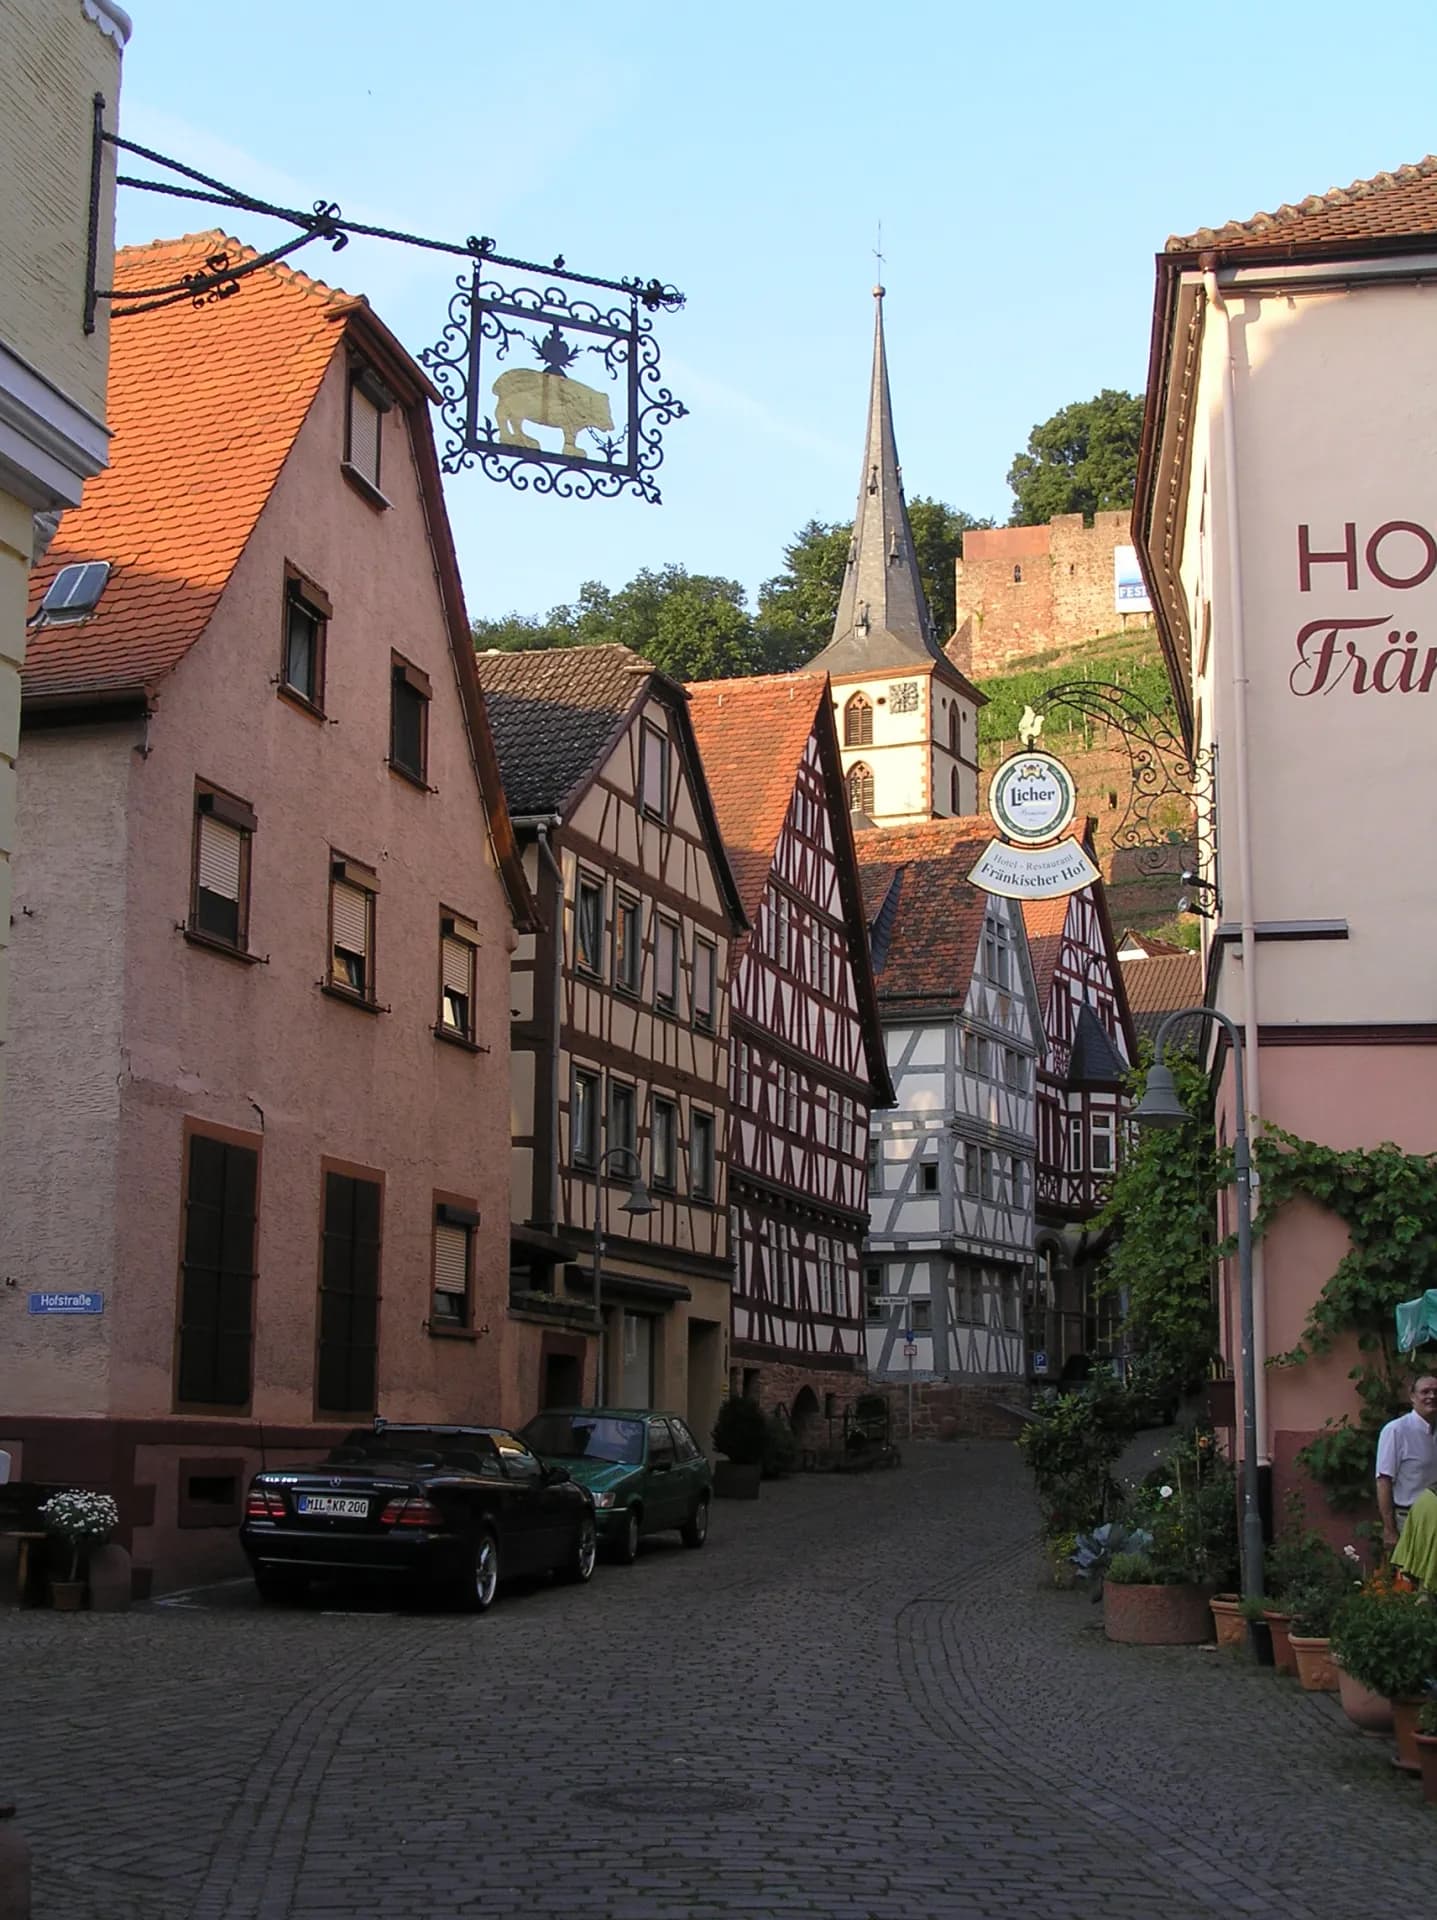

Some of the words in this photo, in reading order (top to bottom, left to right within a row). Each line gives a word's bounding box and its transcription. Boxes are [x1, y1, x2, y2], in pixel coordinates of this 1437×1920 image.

[1011, 787, 1055, 807] Licher
[993, 854, 1018, 869] Hotel
[1026, 854, 1074, 871] Restaurant
[981, 862, 1060, 887] Fränkischer
[1061, 859, 1087, 881] Hof
[41, 1294, 92, 1306] Hofstraße
[308, 1498, 326, 1511] MIL
[333, 1500, 346, 1512] KR
[348, 1501, 367, 1513] 200
